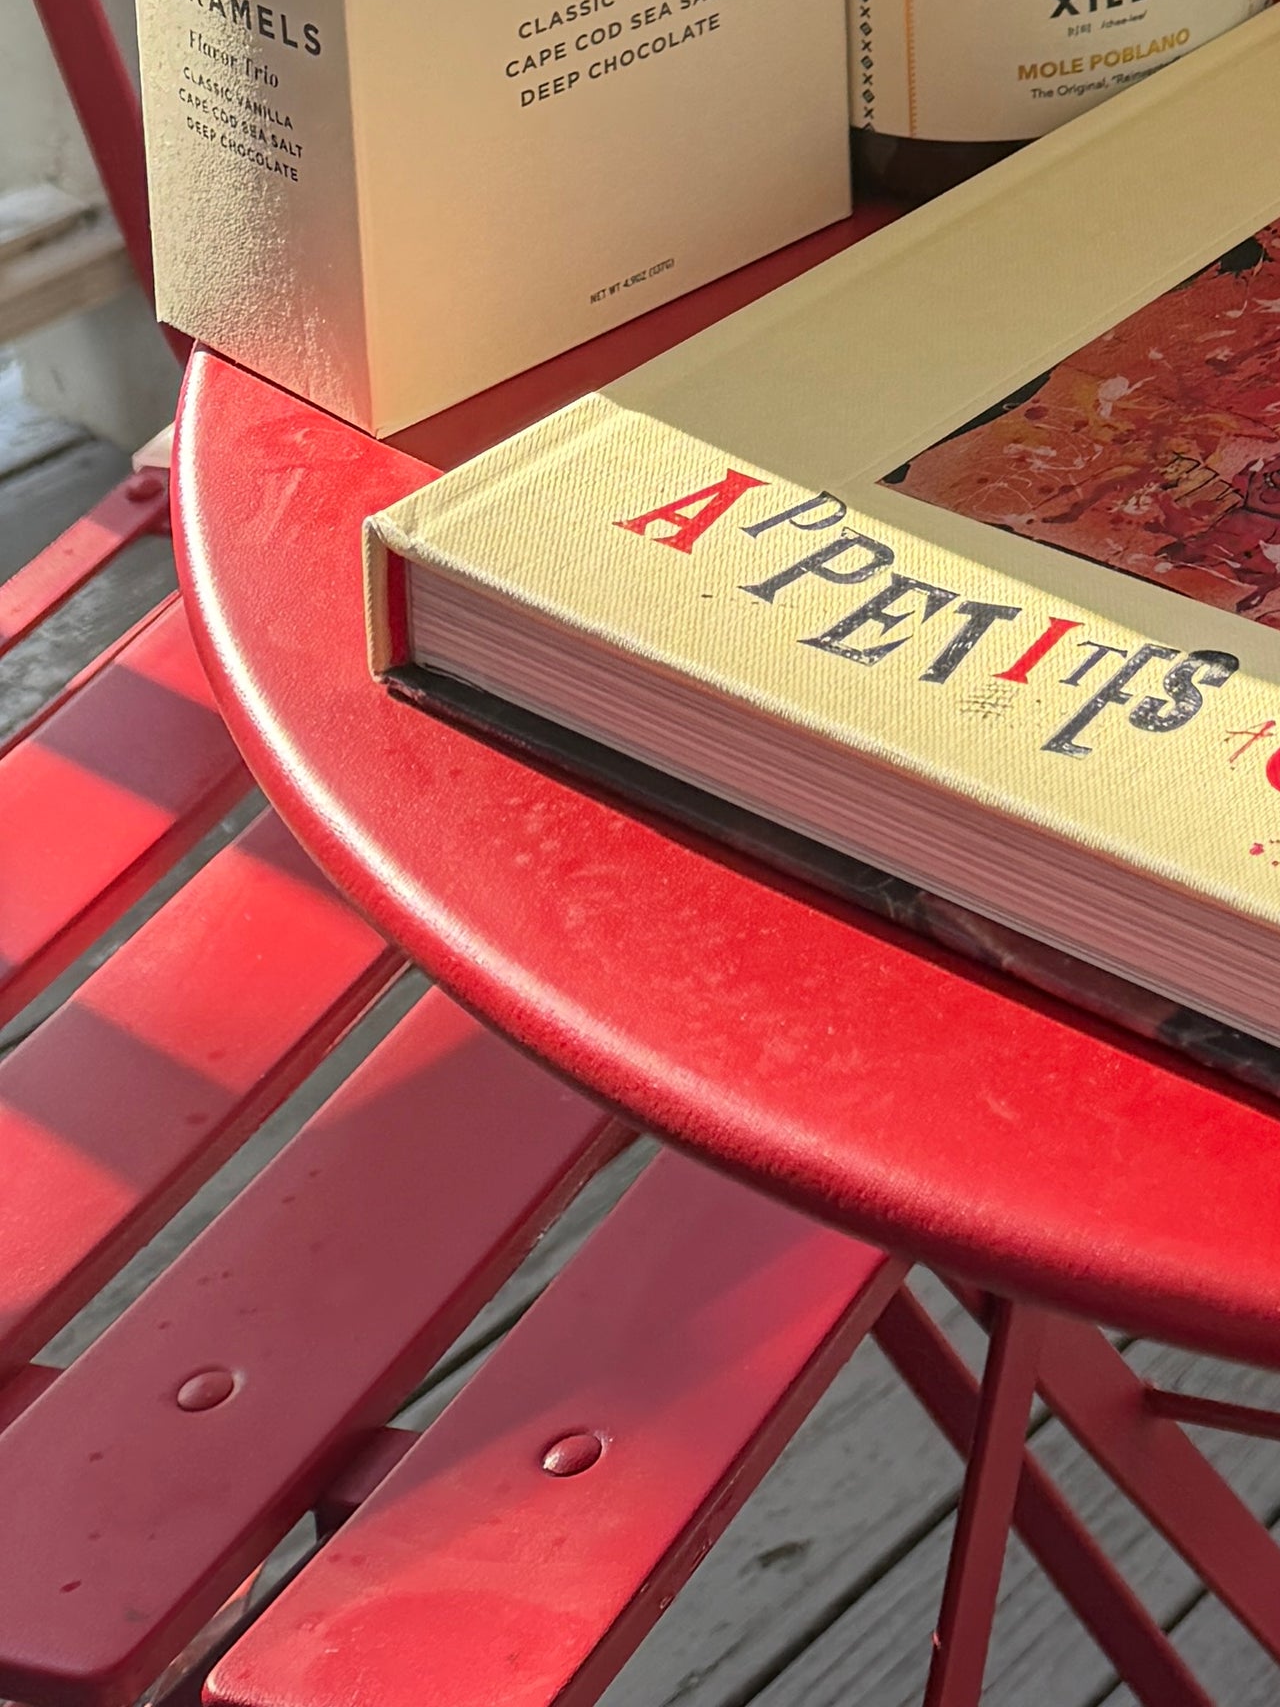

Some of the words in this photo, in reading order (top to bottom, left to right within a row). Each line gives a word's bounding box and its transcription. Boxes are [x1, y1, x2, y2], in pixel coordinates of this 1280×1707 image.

[505, 41, 568, 79] CAPE
[575, 21, 623, 52] COD
[630, 1, 673, 31] SEA
[519, 70, 581, 108] DEEP
[587, 12, 722, 81] CHOCOLATE
[1017, 56, 1084, 81] MOLE
[1089, 27, 1191, 71] POBLANO
[612, 467, 1241, 760] APPETITES
[1225, 718, 1278, 769] A
